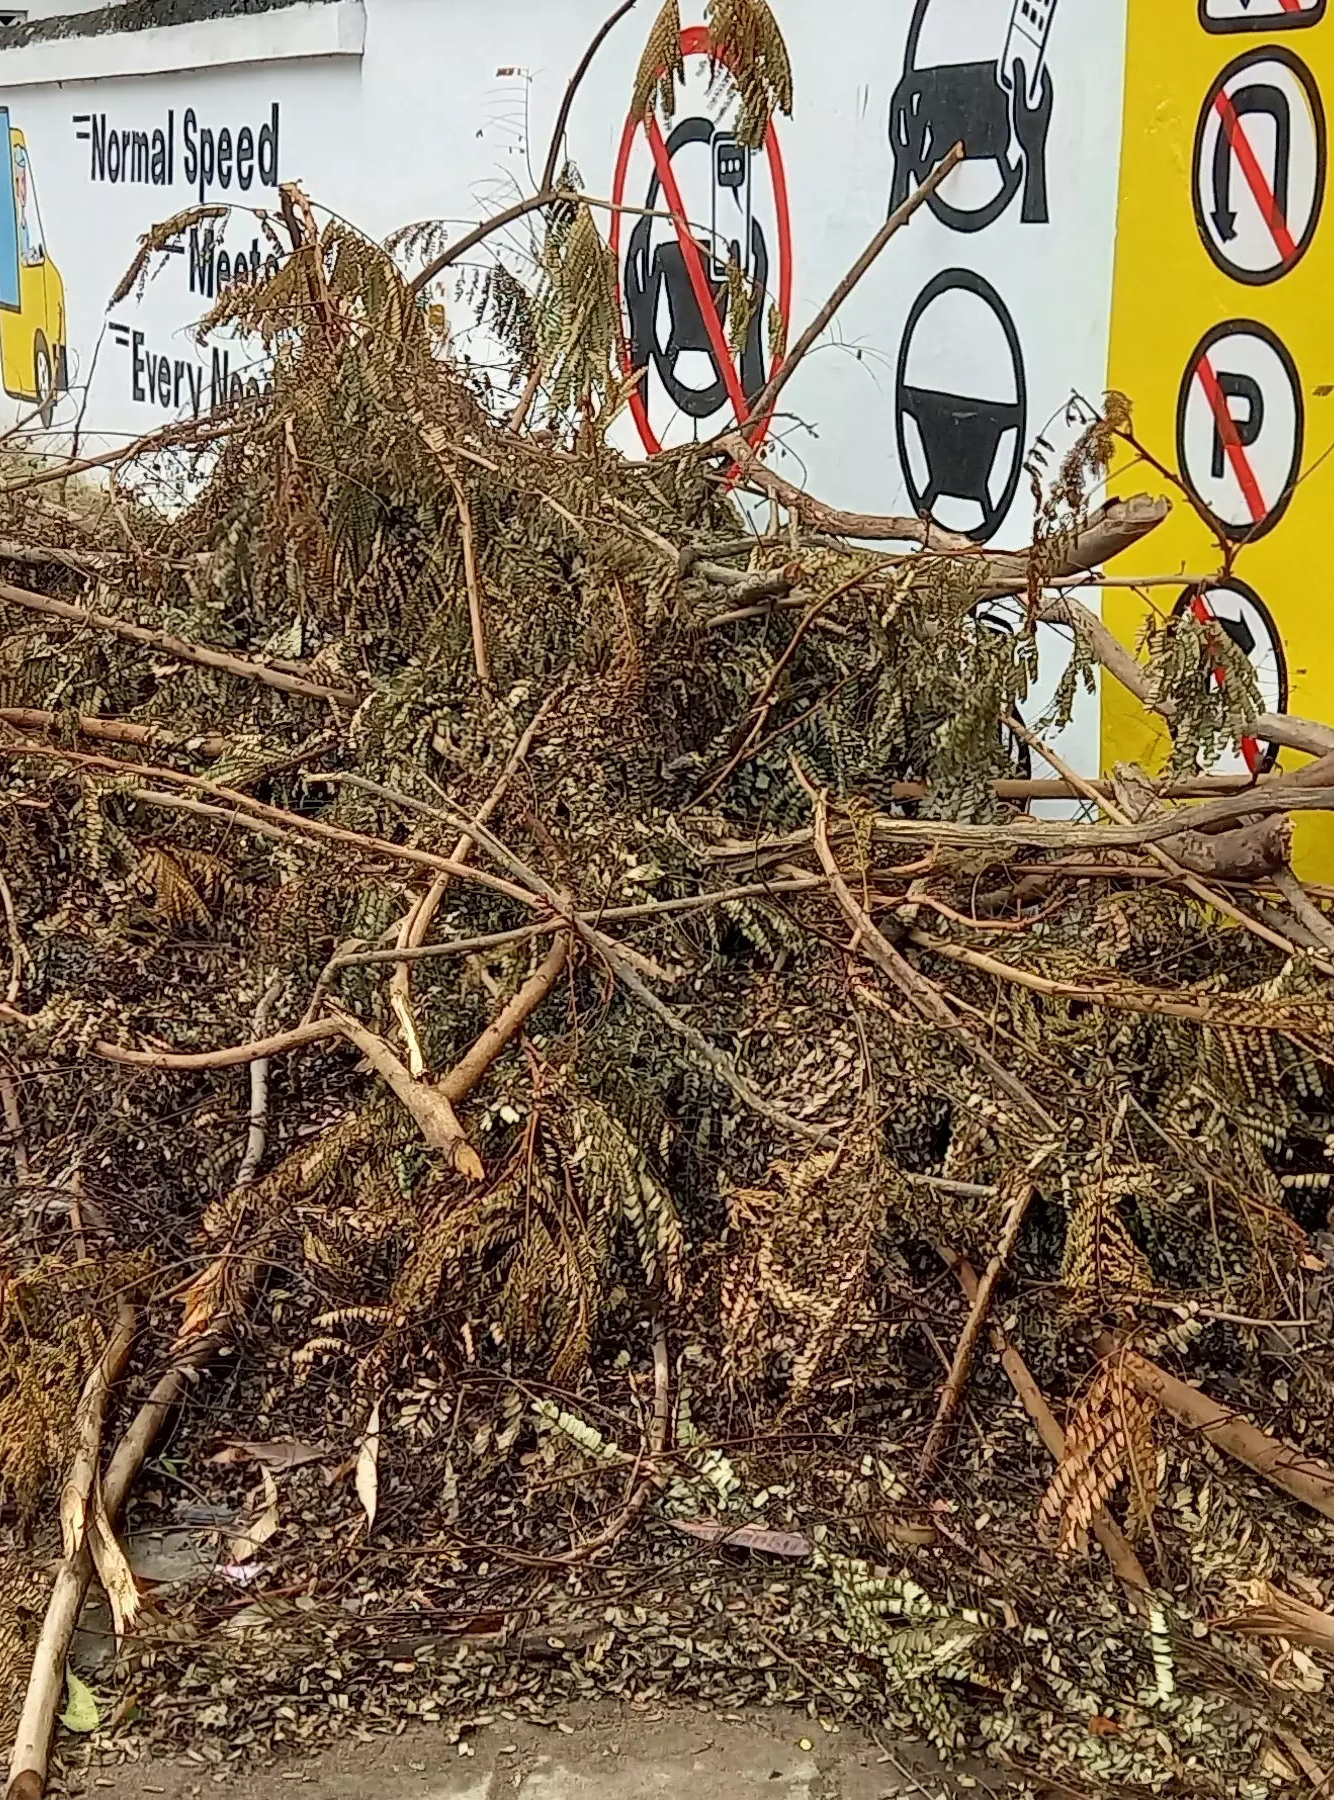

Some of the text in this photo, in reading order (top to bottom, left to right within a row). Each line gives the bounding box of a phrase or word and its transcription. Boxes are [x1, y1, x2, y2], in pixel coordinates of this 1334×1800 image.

[91, 102, 279, 203] Normal Speed
[188, 228, 280, 299] Meet
[132, 330, 203, 419] Every
